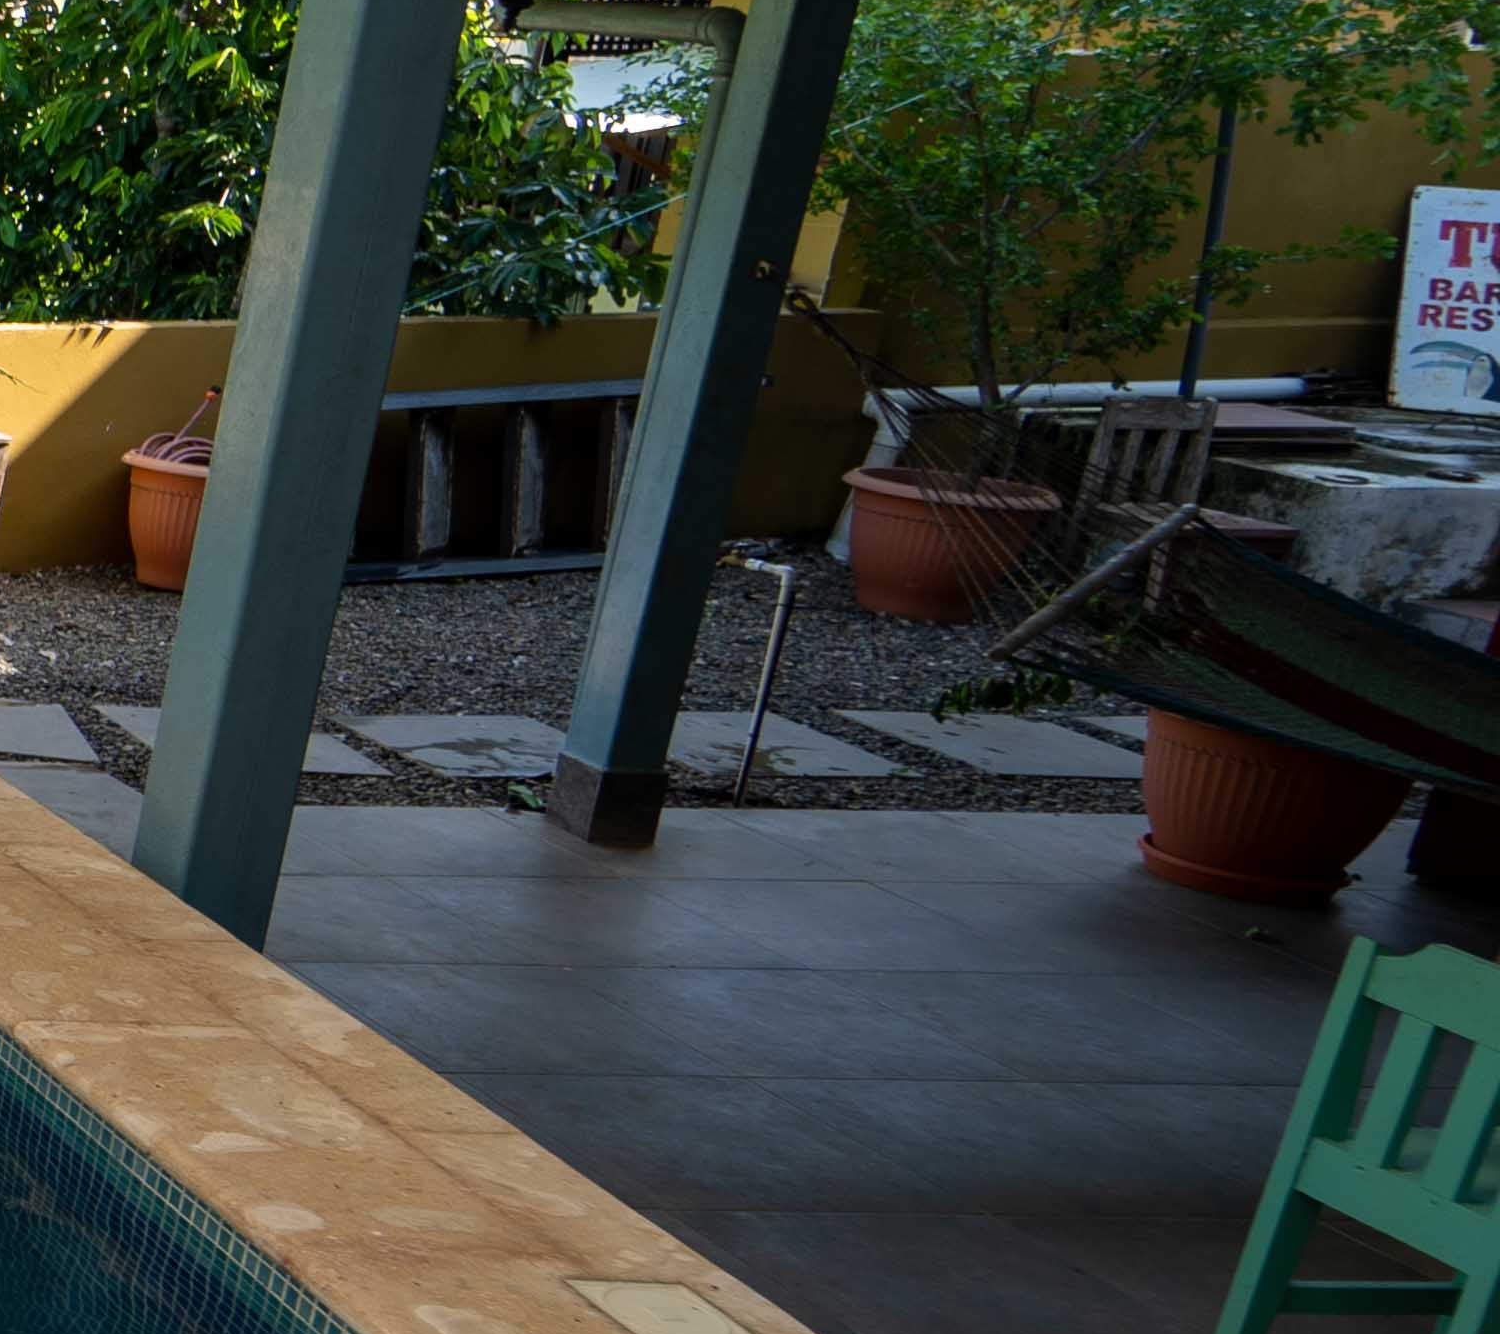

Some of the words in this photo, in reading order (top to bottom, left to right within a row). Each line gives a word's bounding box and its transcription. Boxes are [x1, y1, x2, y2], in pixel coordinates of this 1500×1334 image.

[1439, 219, 1500, 274] T
[1428, 278, 1500, 305] BAR
[1417, 303, 1500, 332] RES
